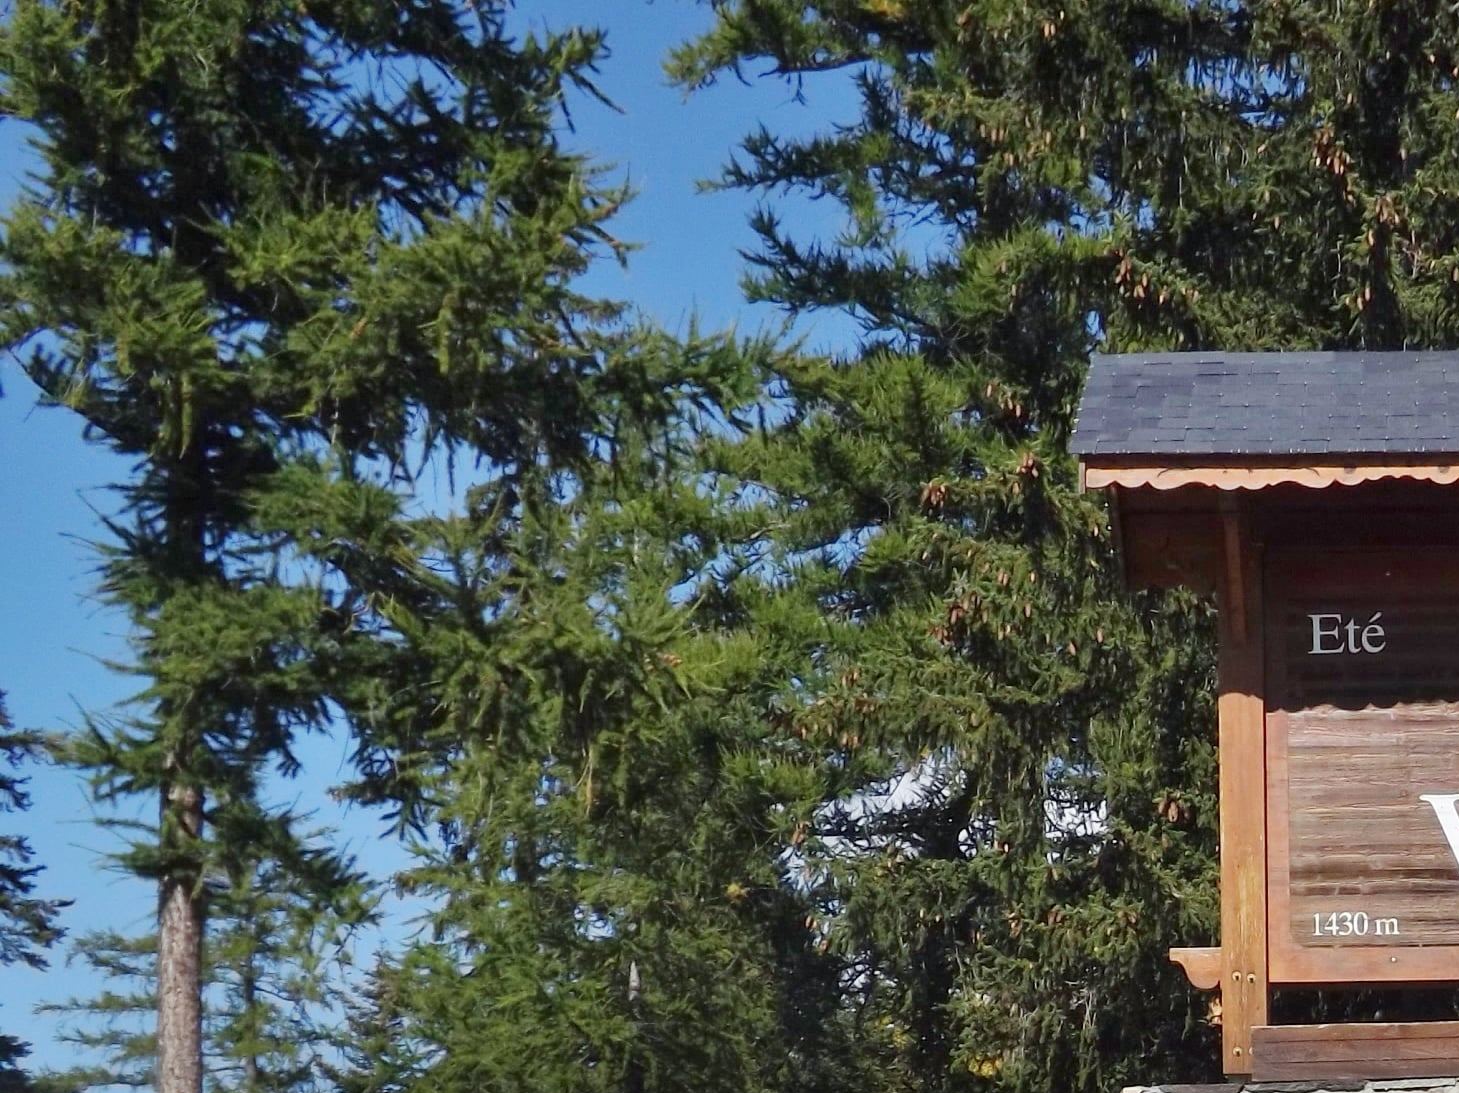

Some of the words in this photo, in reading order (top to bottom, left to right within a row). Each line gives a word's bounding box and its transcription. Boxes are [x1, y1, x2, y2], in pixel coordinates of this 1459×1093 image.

[1308, 612, 1387, 655] Eté
[1312, 911, 1369, 936] 1430
[1374, 917, 1400, 936] m
